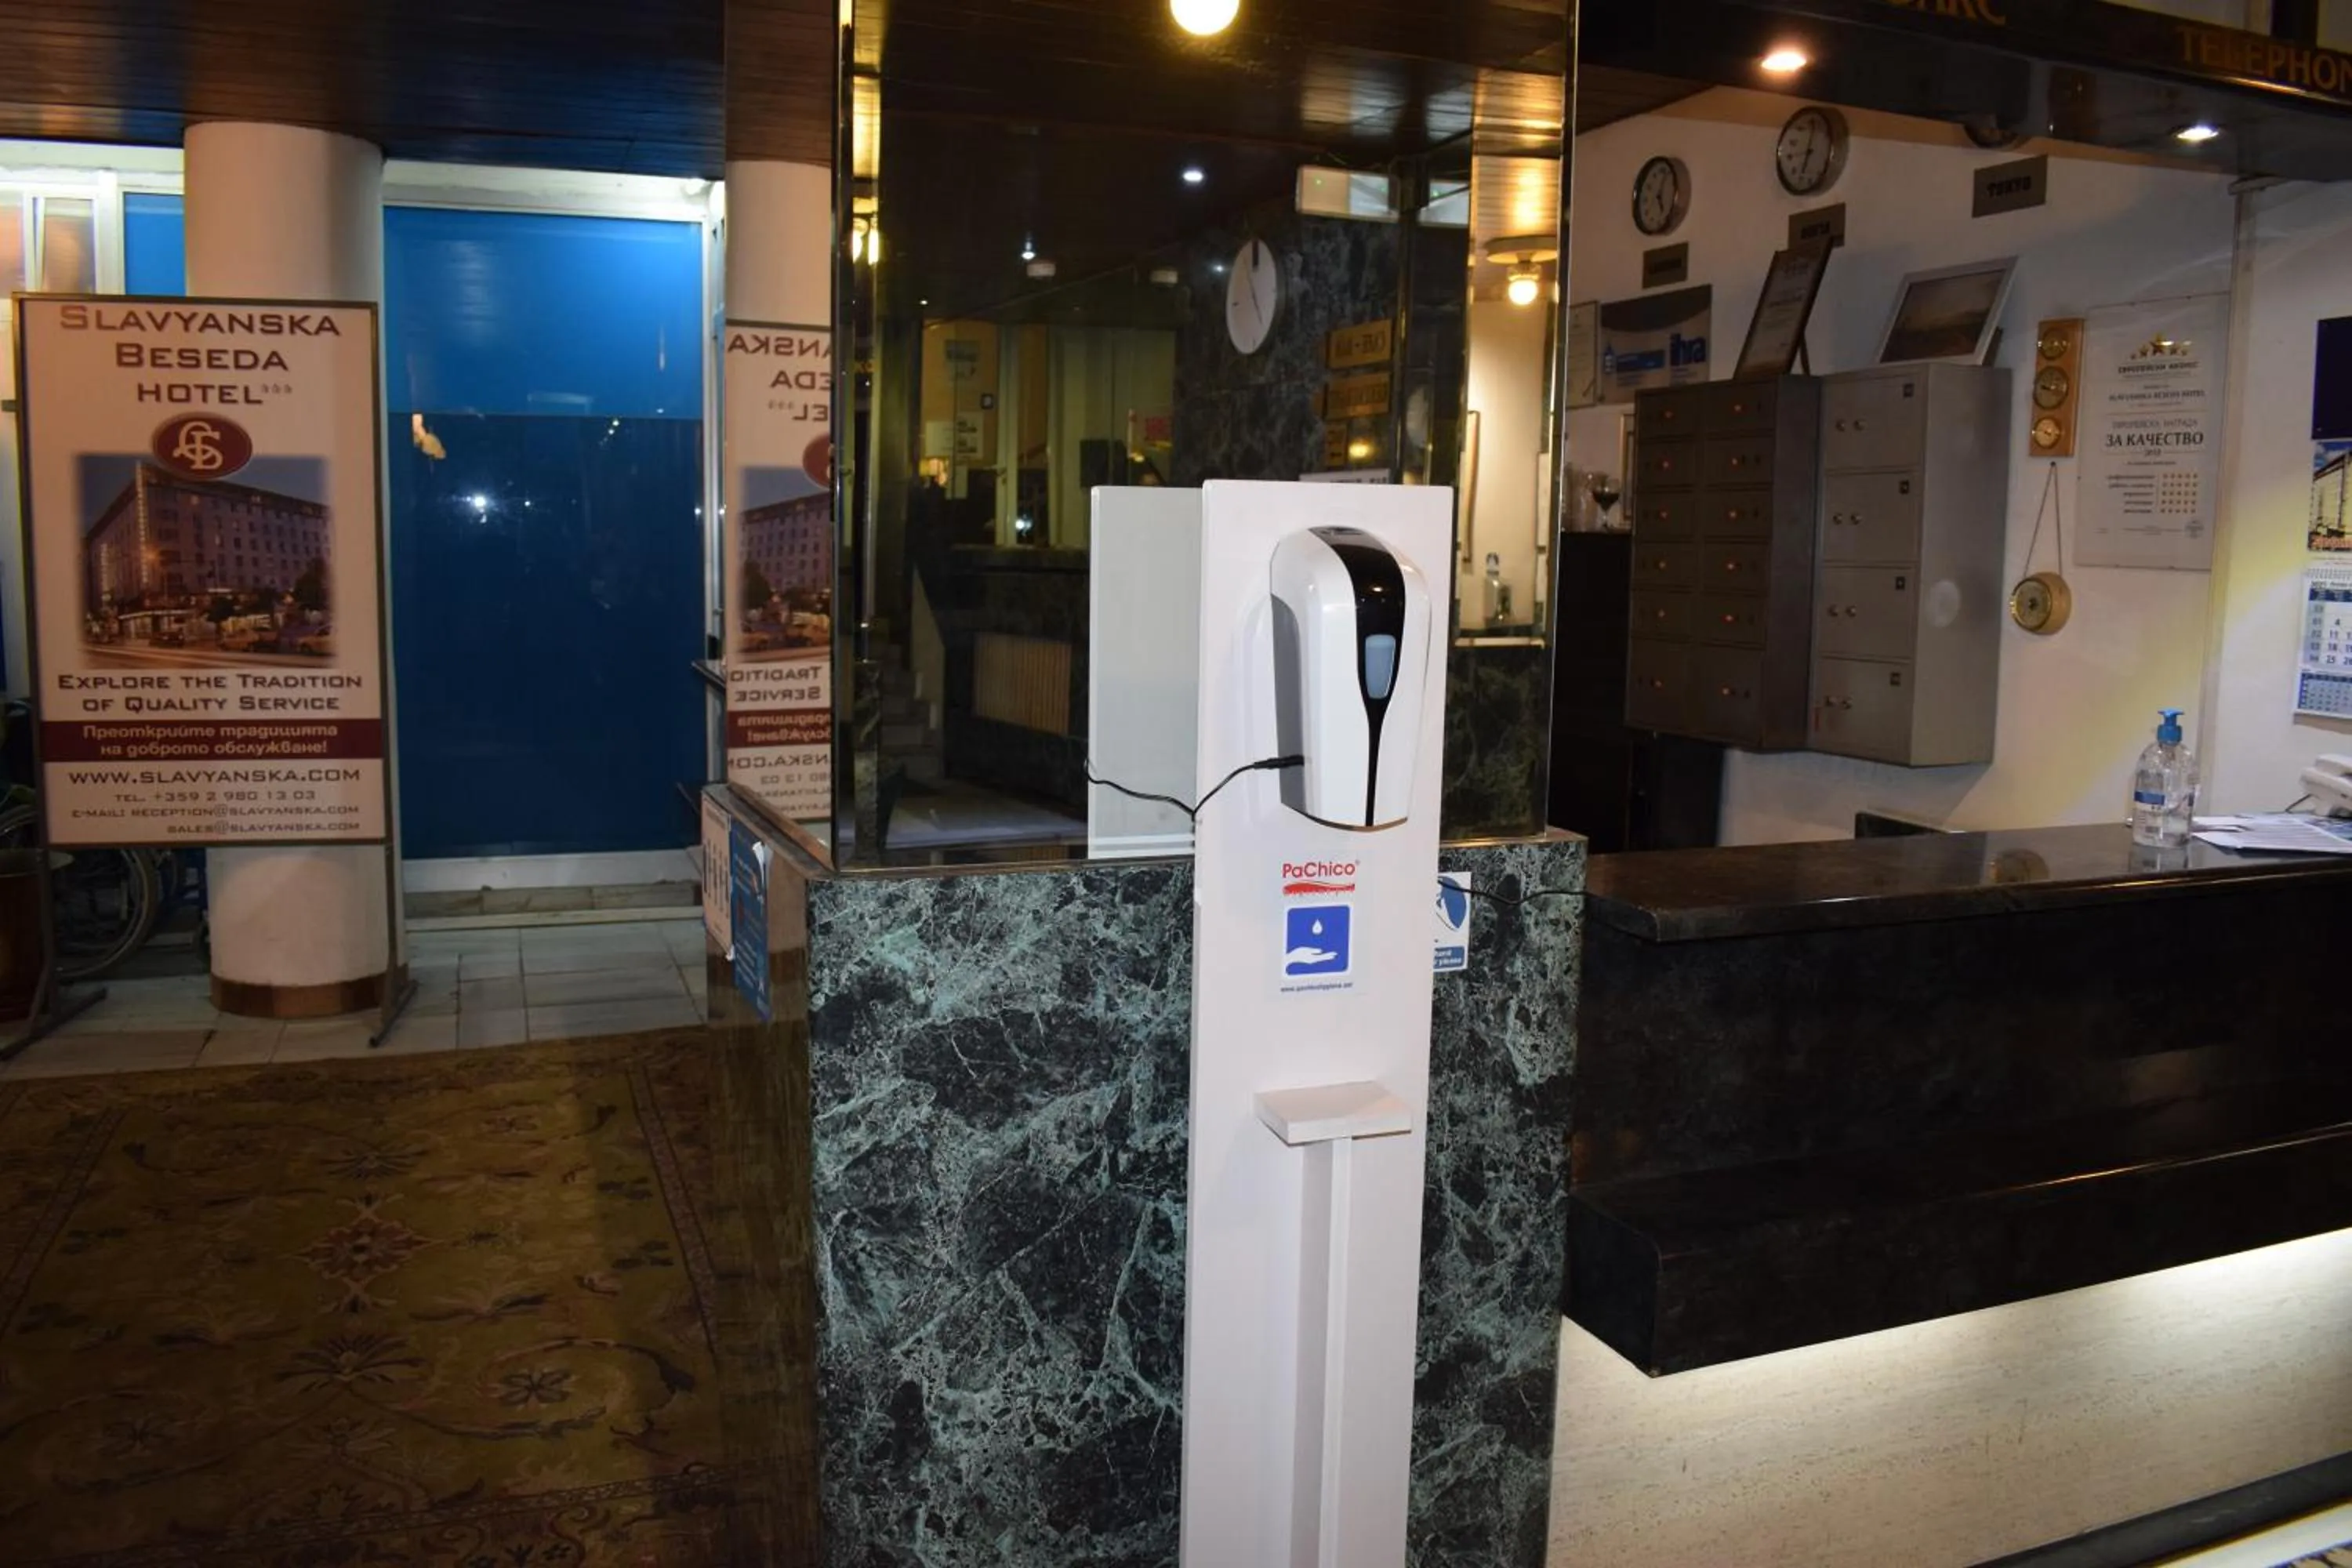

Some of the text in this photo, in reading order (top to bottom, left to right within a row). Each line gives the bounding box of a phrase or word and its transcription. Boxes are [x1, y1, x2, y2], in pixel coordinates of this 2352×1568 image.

[60, 305, 341, 336] SLAVYANSKA
[115, 342, 289, 372] BESEDA
[136, 382, 264, 405] HOTEL
[2105, 431, 2204, 447] ЗА КАЧЕСТВО
[58, 673, 362, 691] EXPLORE THE TRADITION
[82, 696, 340, 714] OF QUALITY SERVICE
[83, 724, 339, 740] Преоткрийте традицията
[101, 741, 327, 758] на доброто обслужване!
[68, 768, 361, 785] WWW.SLAVYANSKA.COM
[153, 791, 200, 802] +359
[206, 791, 217, 801] 2
[223, 790, 258, 801] 980
[267, 790, 287, 800] 13
[293, 790, 316, 800] 03
[1282, 862, 1356, 878] PaChico
